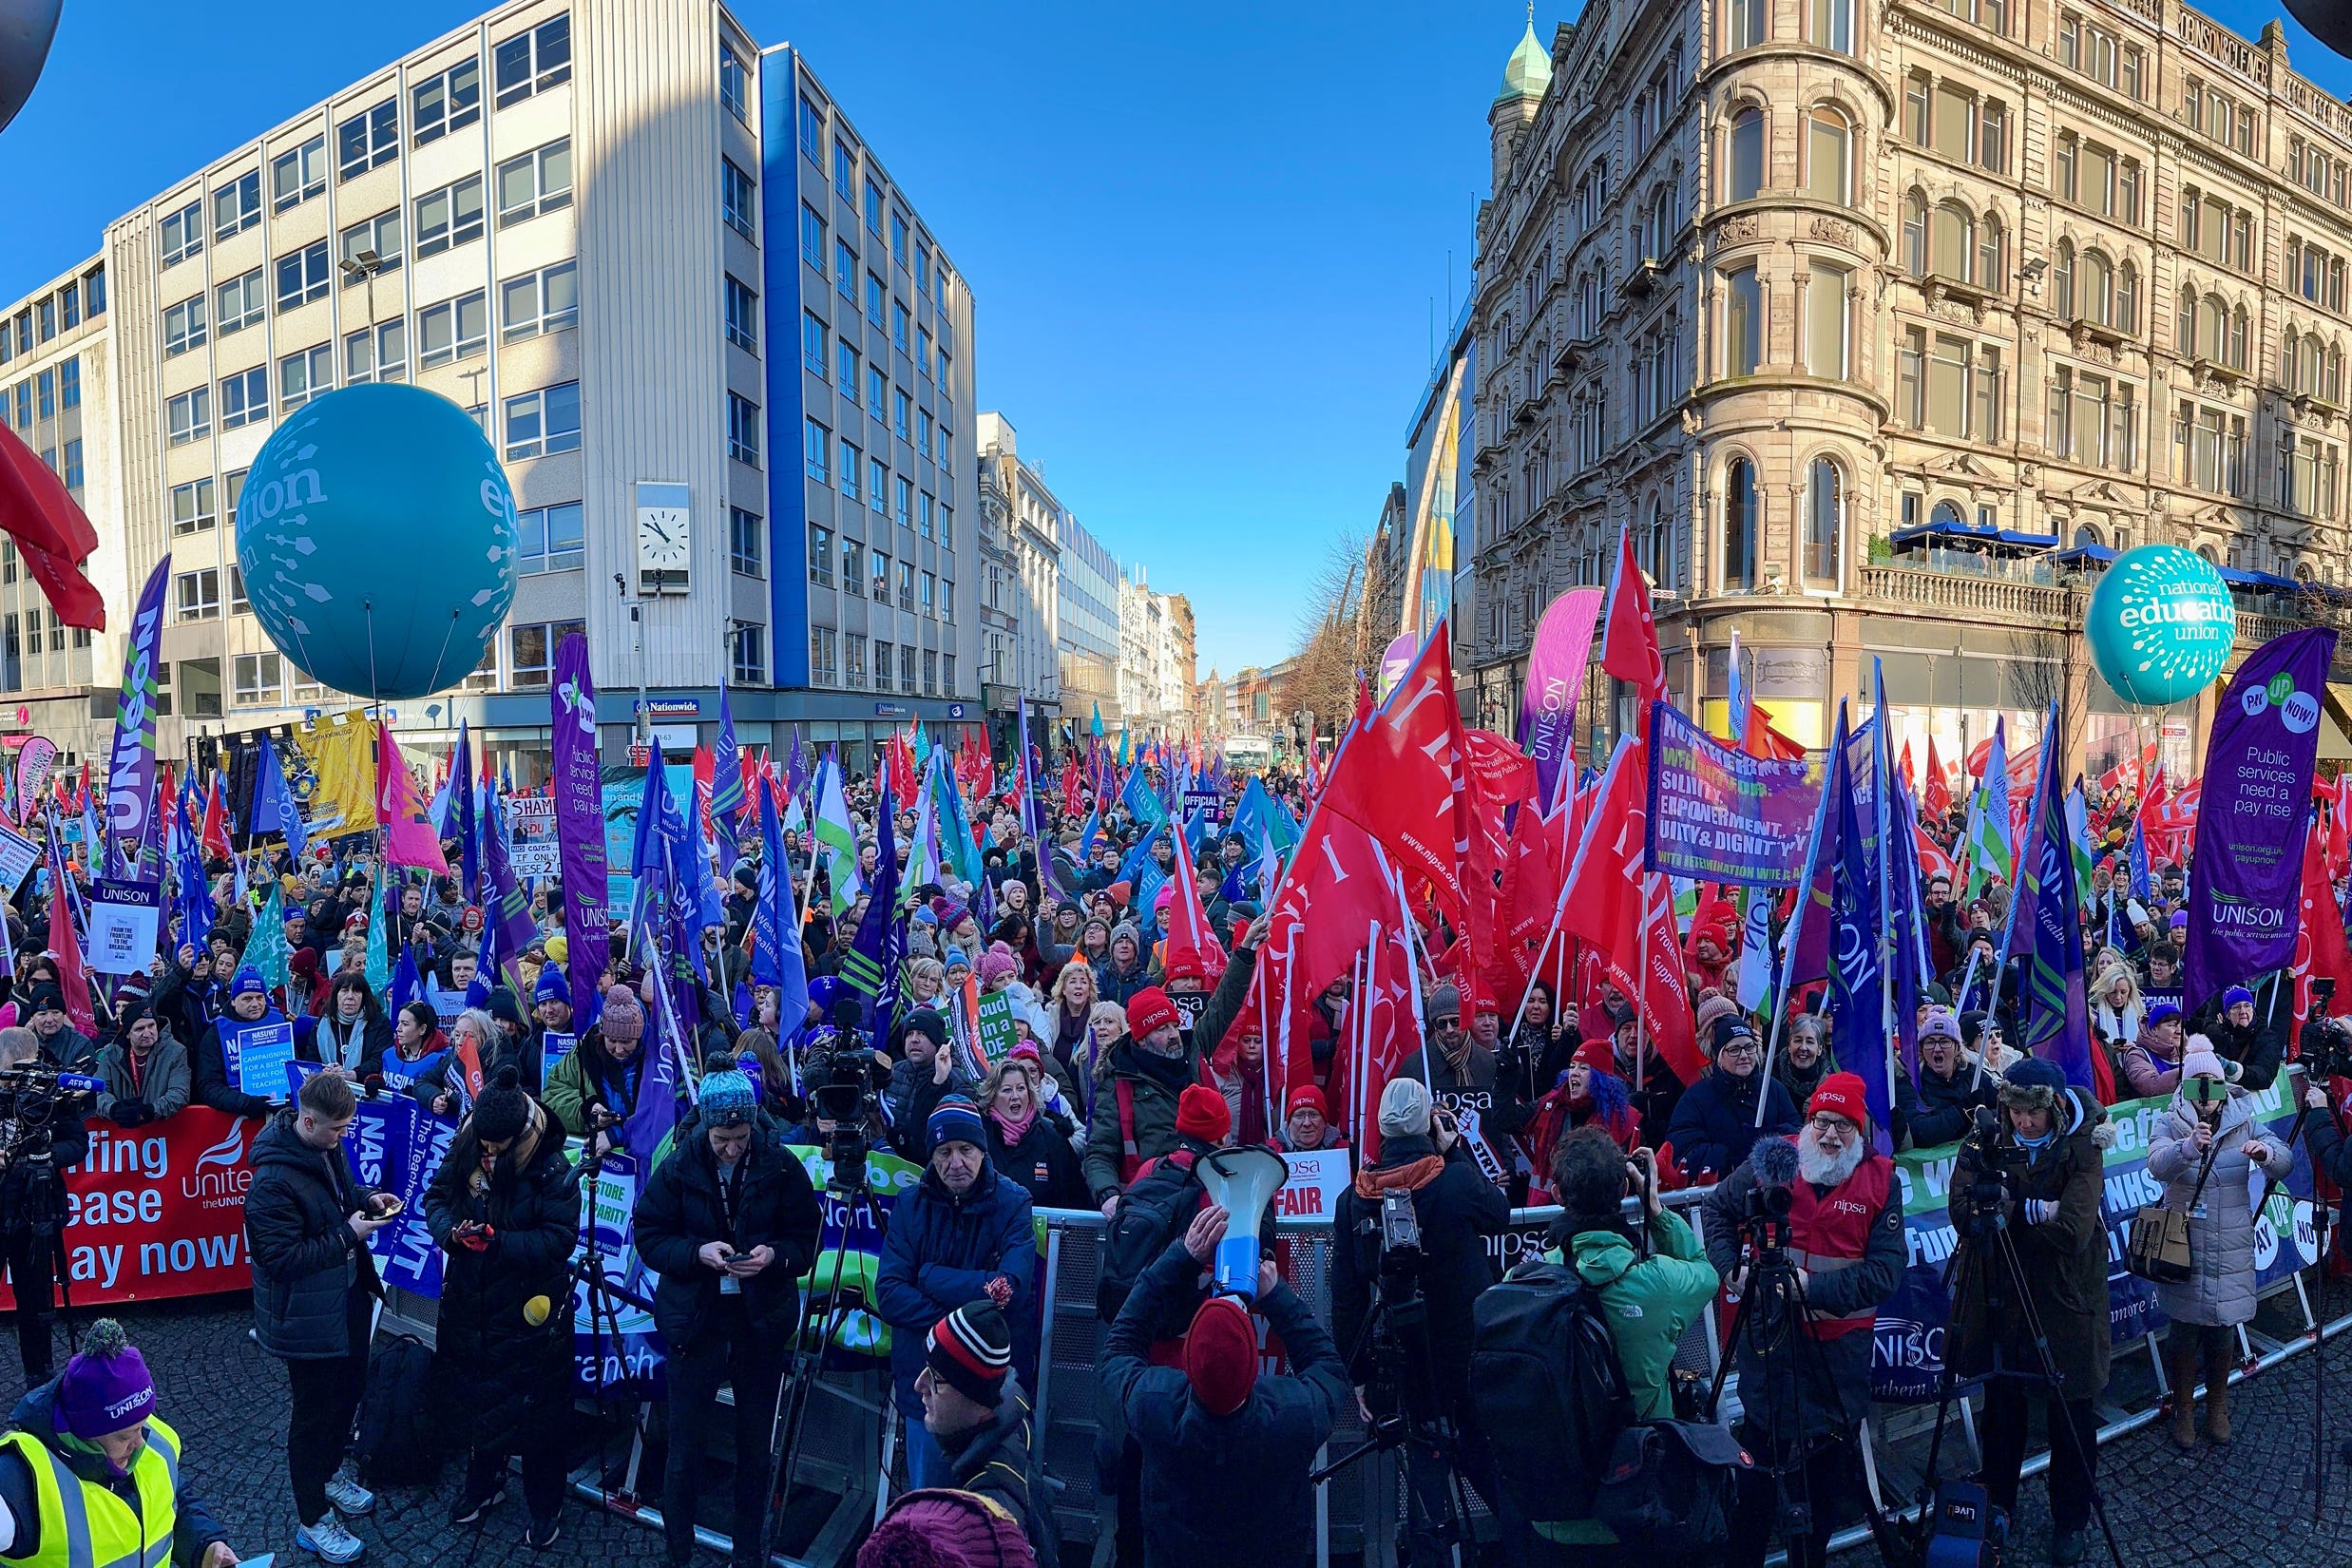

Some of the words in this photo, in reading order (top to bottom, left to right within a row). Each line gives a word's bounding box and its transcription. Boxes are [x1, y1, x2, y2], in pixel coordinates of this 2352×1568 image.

[2159, 579, 2221, 596] national
[2120, 597, 2235, 627] educatio
[2174, 623, 2219, 640] union
[1568, 675, 1578, 700] union
[2270, 679, 2291, 698] UP
[650, 701, 698, 712] Nationwide
[2247, 691, 2264, 709] PAY
[106, 608, 158, 831] UNISON
[1536, 678, 1565, 761] UNISON
[1562, 700, 1574, 727] service
[2285, 699, 2314, 725] NOW!
[1558, 729, 1567, 750] public
[2247, 747, 2290, 767] Public
[570, 761, 595, 781] service
[2238, 764, 2296, 785] services
[1184, 795, 1218, 806] OFFICIAL
[2240, 781, 2274, 800] need
[2280, 787, 2288, 800] a
[1187, 808, 1214, 818] PIKET
[2234, 798, 2261, 817] pay
[2266, 800, 2291, 817] rise
[534, 852, 558, 862] ONLY
[1401, 831, 1460, 892] www.nipsa.org.
[512, 864, 543, 876] THESE
[544, 862, 553, 873] 2
[103, 889, 150, 903] UNISON
[2212, 904, 2285, 927] UNISON
[2224, 928, 2245, 939] public
[2246, 929, 2269, 938] service
[979, 994, 1007, 1018] oud
[1142, 1007, 1170, 1027] nipsa
[252, 1028, 278, 1041] NASUWT
[982, 1022, 998, 1039] in
[1000, 1018, 1011, 1033] a
[242, 1049, 292, 1063] CAMPAIGNING
[244, 1063, 258, 1072] FOR
[252, 1071, 270, 1080] DEAL
[270, 1069, 284, 1078] FOR
[67, 1079, 85, 1088] AFP
[251, 1079, 286, 1089] TEACHERS
[1292, 1096, 1315, 1106] nipsa
[1430, 1090, 1492, 1112] ipsa
[1816, 1091, 1845, 1104] nipsa
[419, 1119, 433, 1143] The
[182, 1166, 253, 1199] unite
[581, 1176, 626, 1202] RSTORE
[2106, 1170, 2164, 1214] NHS
[1274, 1186, 1324, 1217] FAIR
[1833, 1198, 1867, 1215] nipsa
[2270, 1197, 2289, 1228] UP
[70, 1243, 124, 1289] ay
[140, 1223, 252, 1276] now!
[1907, 1225, 1960, 1268] Fun
[1871, 1327, 1945, 1367] NISO
[575, 1346, 655, 1383] ranch
[109, 1385, 153, 1419] UNISON
